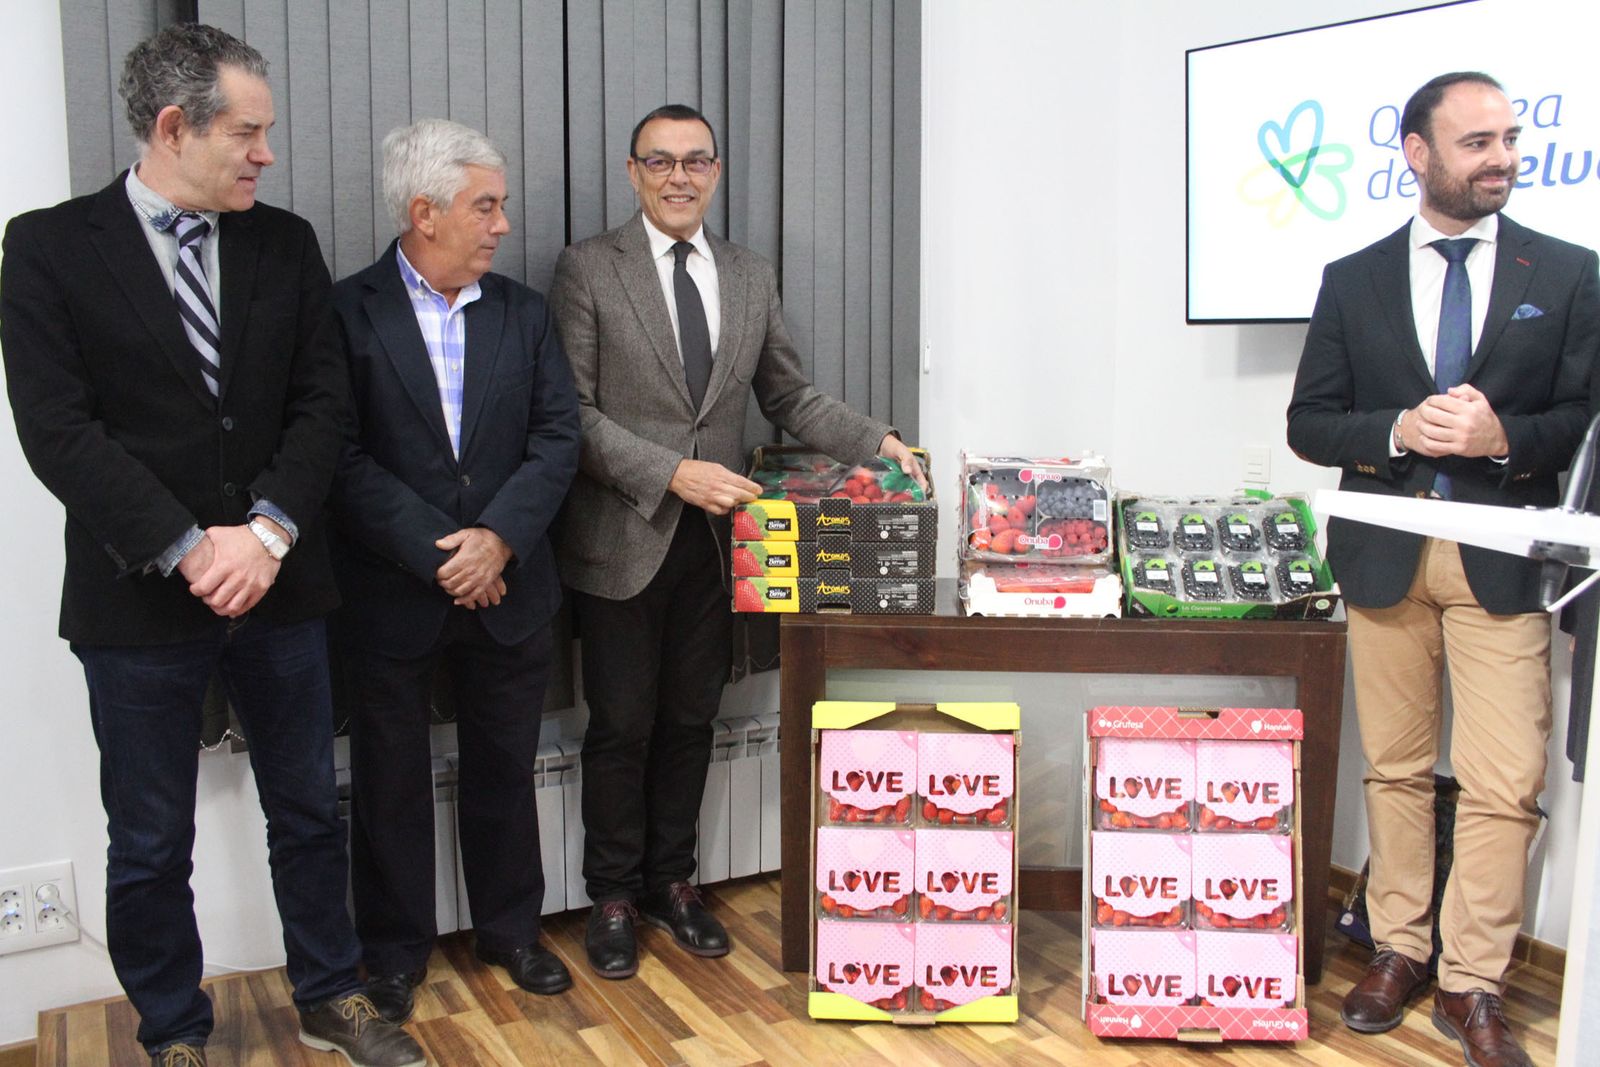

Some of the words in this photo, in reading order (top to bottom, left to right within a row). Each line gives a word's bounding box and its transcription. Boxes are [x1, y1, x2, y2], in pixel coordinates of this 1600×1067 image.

[1024, 597, 1054, 606] Onuba
[1113, 719, 1144, 729] Grufesa
[832, 770, 903, 793] LOVE
[928, 773, 1000, 796] LOVE
[1109, 776, 1182, 800] LOVE
[1206, 780, 1280, 804] LOVE
[828, 869, 900, 893] LOVE
[926, 870, 999, 894] LOVE
[1105, 874, 1178, 899] LOVE
[1205, 877, 1278, 901] LOVE
[828, 961, 900, 986] LOVE
[925, 964, 998, 988] LOVE
[1108, 973, 1182, 998] LOVE
[1207, 974, 1281, 1000] LOVE
